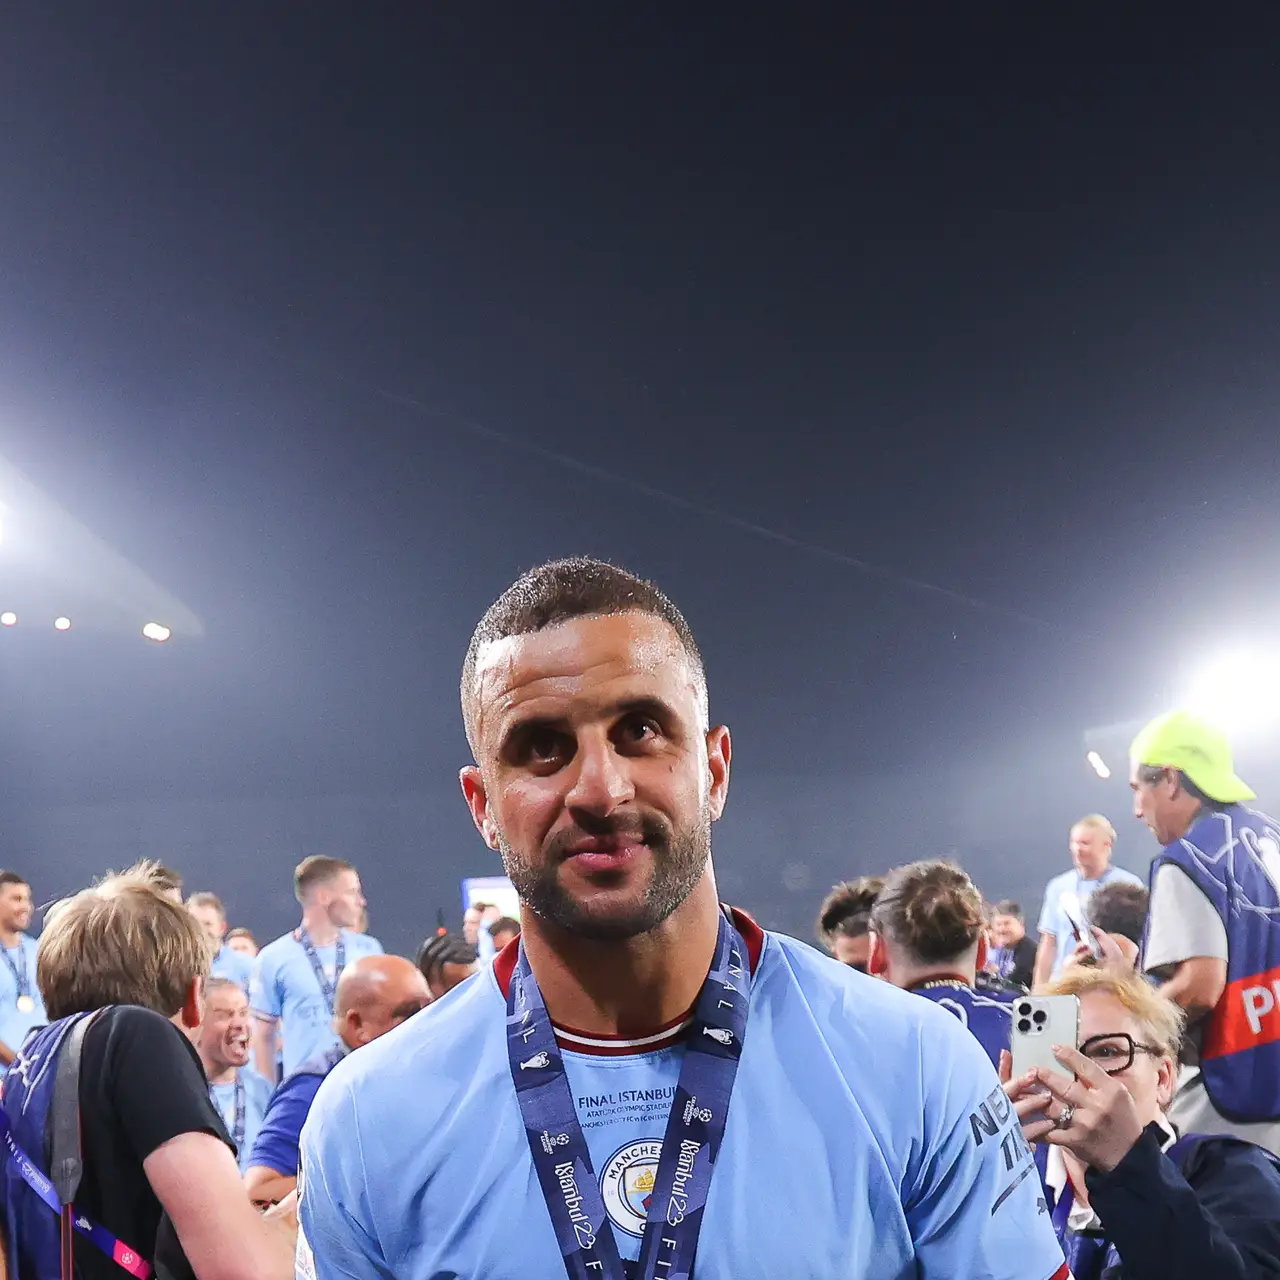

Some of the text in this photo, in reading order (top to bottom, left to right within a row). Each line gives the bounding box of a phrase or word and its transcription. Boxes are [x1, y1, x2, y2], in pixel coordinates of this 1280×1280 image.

[578, 1094, 617, 1109] FINAL
[646, 1101, 673, 1111] STADIU
[608, 1145, 661, 1180] MANCHE
